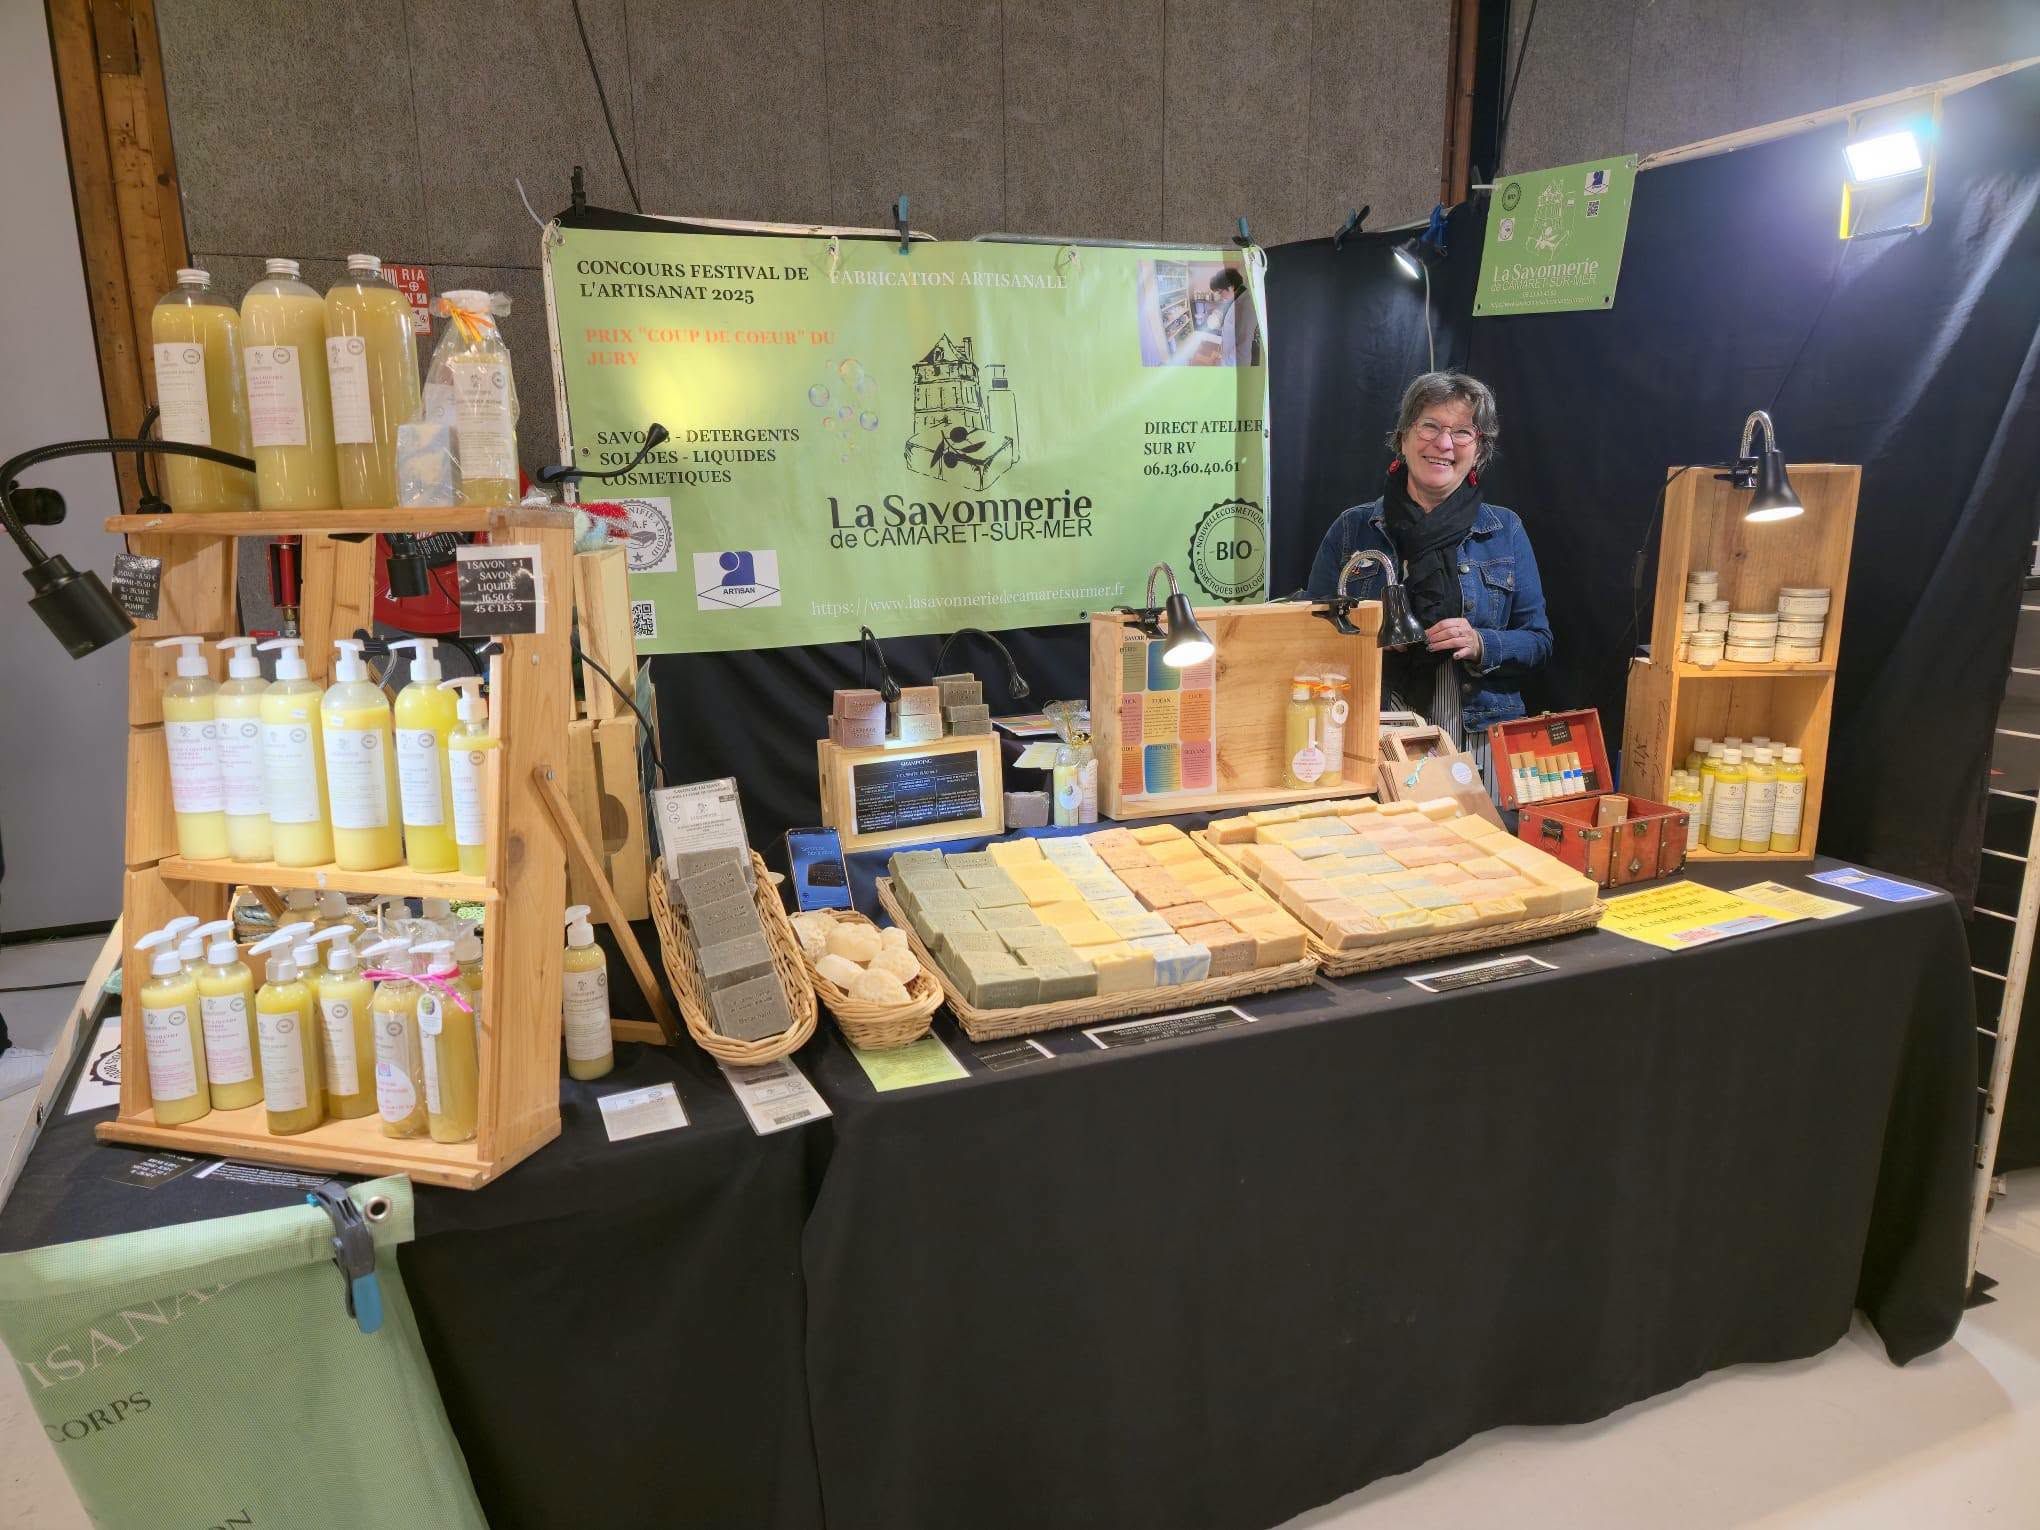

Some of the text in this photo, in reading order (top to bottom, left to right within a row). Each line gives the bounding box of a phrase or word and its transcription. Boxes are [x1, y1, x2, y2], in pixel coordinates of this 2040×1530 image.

[401, 268, 425, 281] RIA
[577, 259, 809, 281] CONCOURS FESTIVAL DE
[1512, 258, 1599, 280] Savonnerie
[831, 270, 1068, 290] FABRICATION ARTISANALE
[580, 282, 755, 305] L'ARTISANAT 2025
[586, 328, 634, 344] PRIX
[705, 329, 730, 344] DE
[811, 331, 836, 345] DU
[587, 352, 640, 367] JURY
[1145, 419, 1263, 435] DIRECT ATELIER
[686, 428, 801, 443] DETERGENTS
[1144, 441, 1197, 456] SUR RV
[693, 449, 777, 465] LIQUIDES
[1144, 460, 1241, 477] 06.13.60.40.61
[827, 489, 1093, 530] La Savonnerie
[830, 518, 1093, 550] de CAMARET-SUR-MER
[1216, 540, 1252, 561] BIO
[467, 561, 471, 569] 1
[472, 560, 505, 569] SAVON
[480, 571, 513, 580] SAVON
[477, 581, 517, 592] LIQUIDE
[723, 587, 755, 595] ARTISAN
[507, 593, 514, 601] €
[810, 584, 1125, 616] https://www.lasavonneriedecamaretsurmer.fr
[474, 603, 523, 613] 45 € LES 3
[44, 1391, 152, 1443] CORPS
